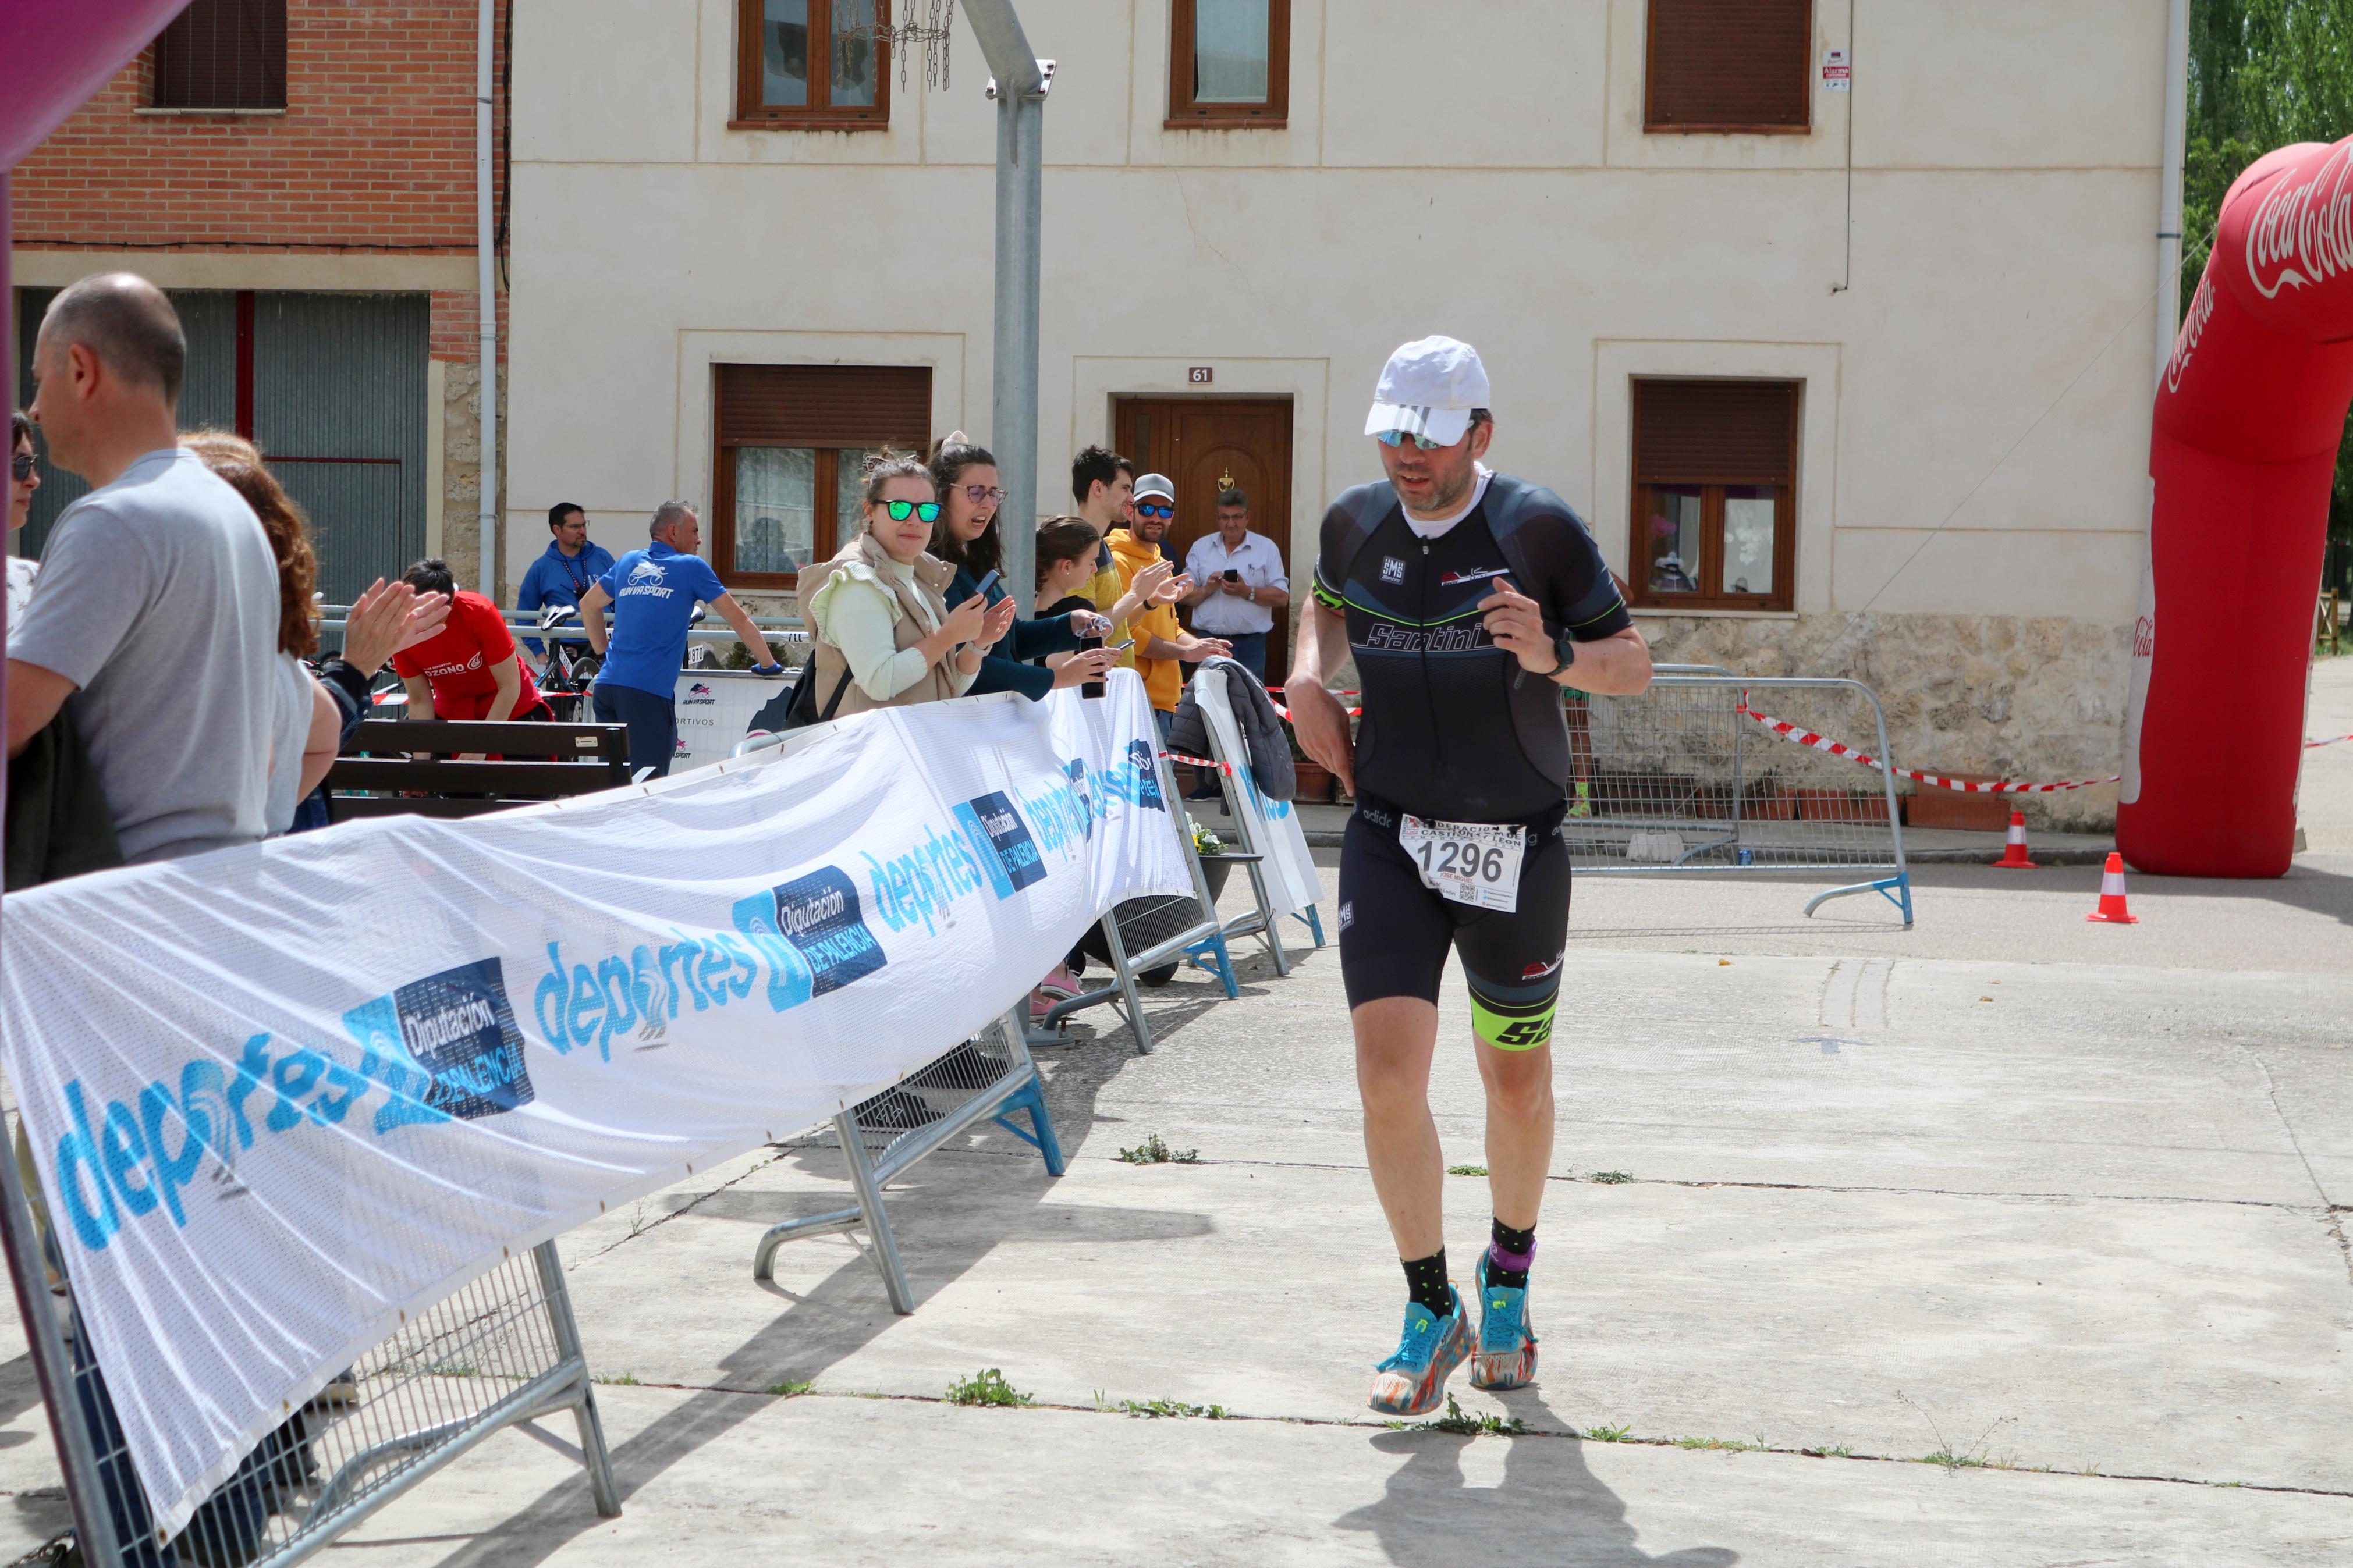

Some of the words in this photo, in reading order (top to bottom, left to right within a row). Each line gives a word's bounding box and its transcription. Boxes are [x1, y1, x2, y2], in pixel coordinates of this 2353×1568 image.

[1193, 369, 1208, 382] 61
[1368, 623, 1482, 650] Santini
[692, 647, 703, 662] 870
[424, 664, 464, 677] OZONO
[1363, 810, 1392, 828] adid
[1492, 836, 1521, 846] LEON
[1417, 841, 1504, 883] 1296
[858, 823, 983, 937] deportes
[1453, 875, 1474, 884] MIGUEL
[781, 886, 844, 937] Diputación
[817, 923, 876, 966] PALENCIA
[534, 928, 757, 1063] deportes
[404, 991, 495, 1060] Diputación
